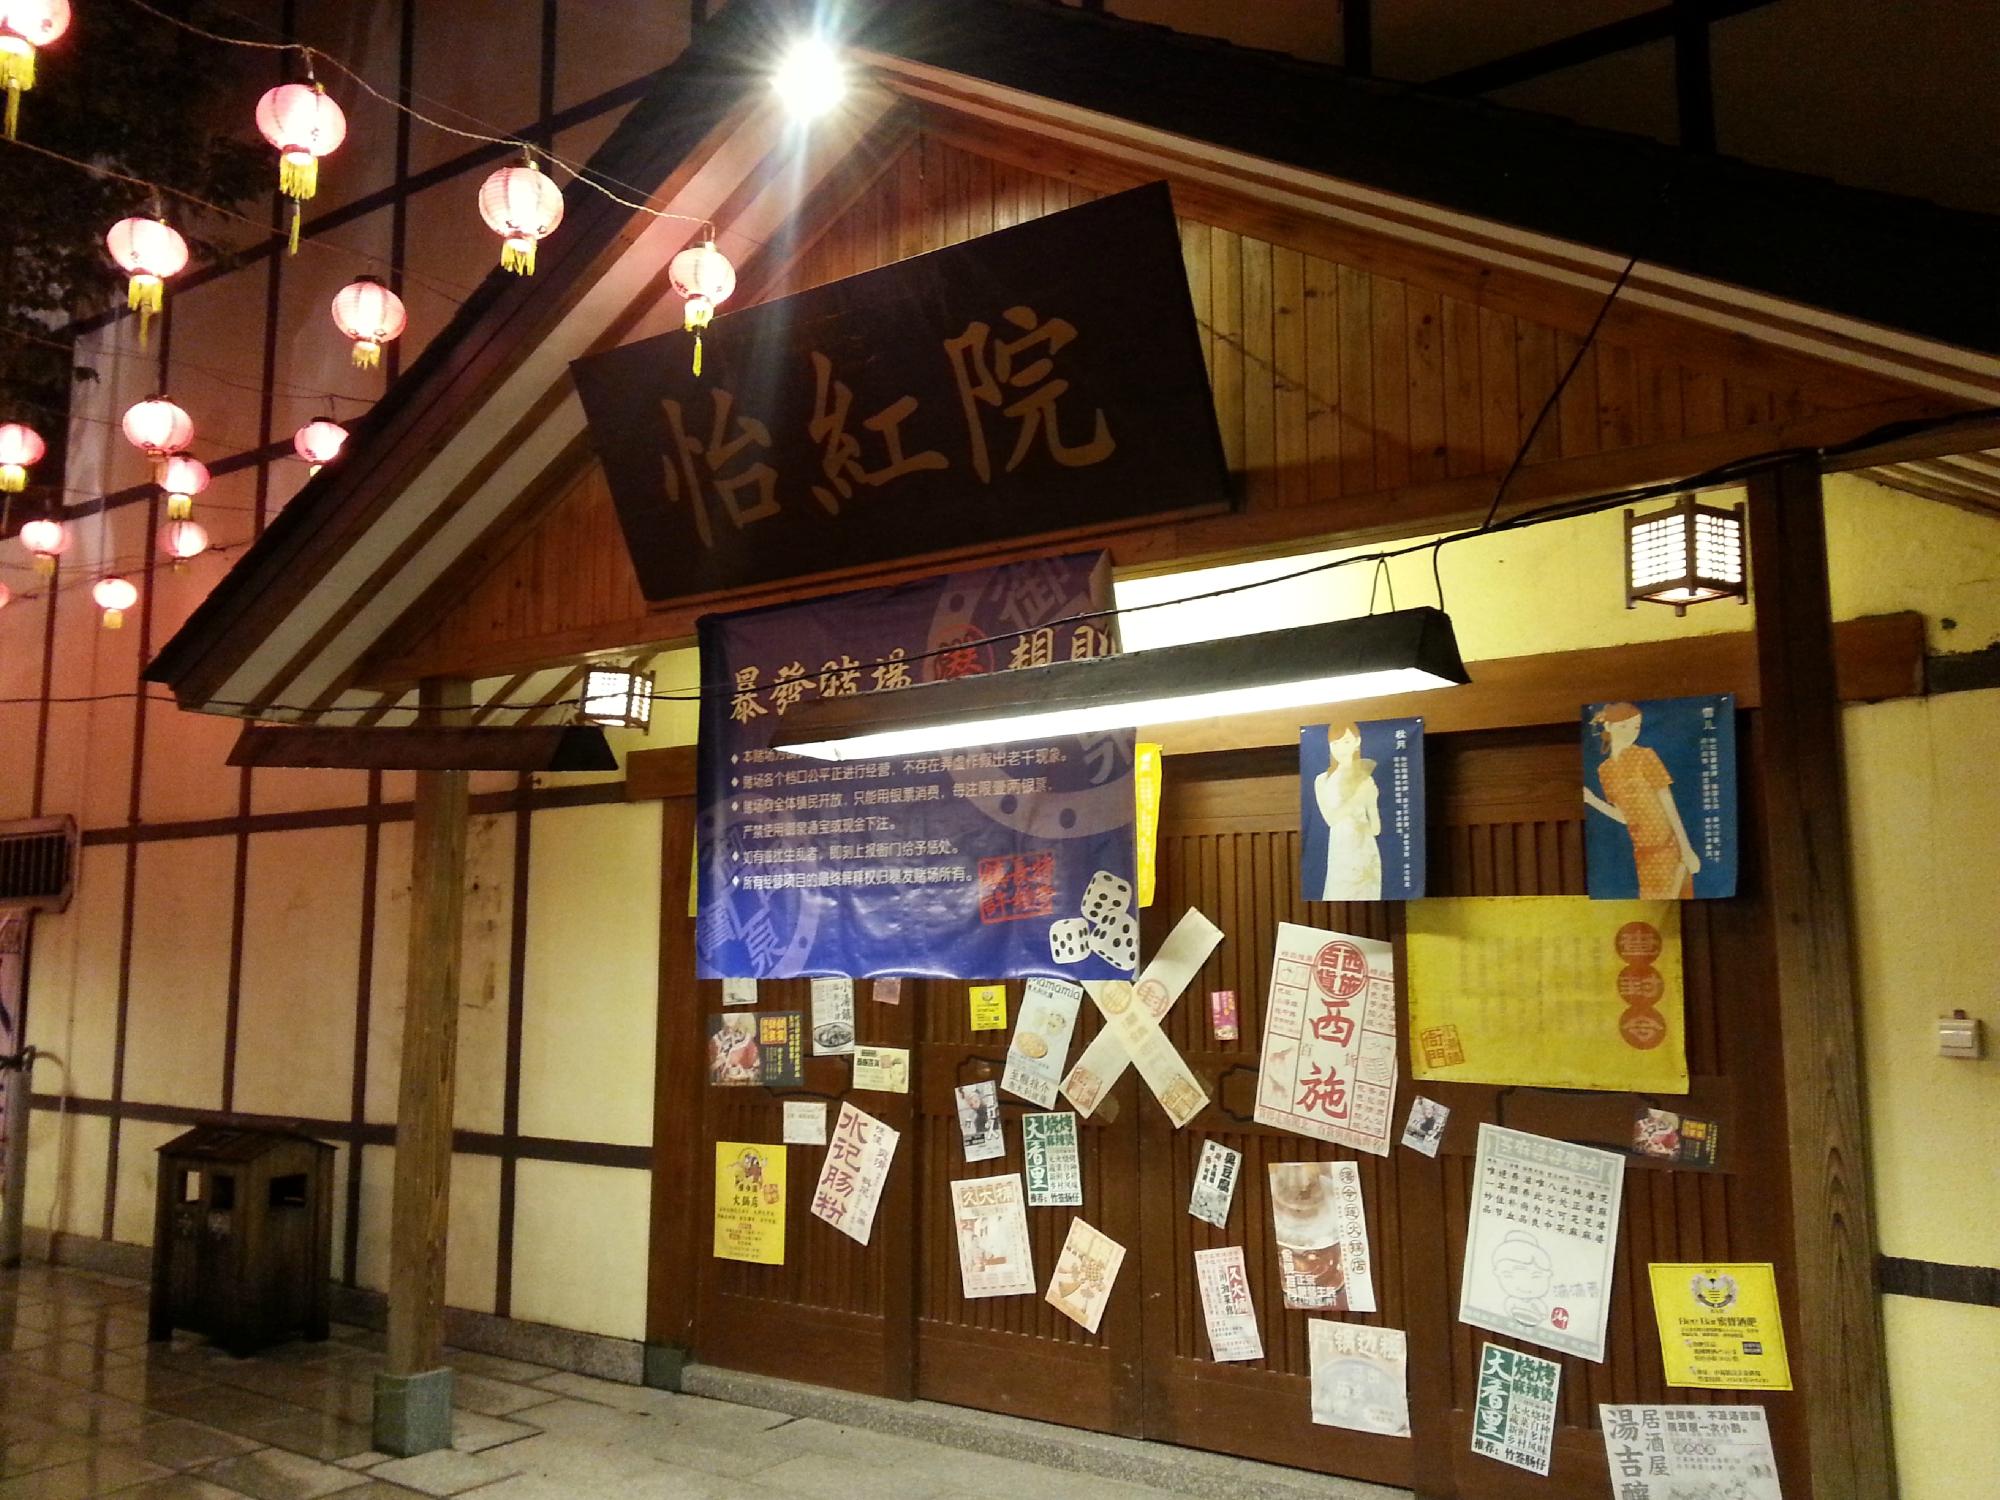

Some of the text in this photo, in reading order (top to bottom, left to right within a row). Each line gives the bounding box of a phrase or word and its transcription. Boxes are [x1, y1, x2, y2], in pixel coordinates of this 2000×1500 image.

[662, 305, 1117, 549] 怡紅院
[1619, 929, 1664, 1044] 查封令
[1296, 998, 1356, 1120] 西施
[815, 1111, 869, 1226] 水记肠粉
[1478, 1349, 1512, 1443] 大香里
[1641, 1409, 1671, 1477] 居酒屋
